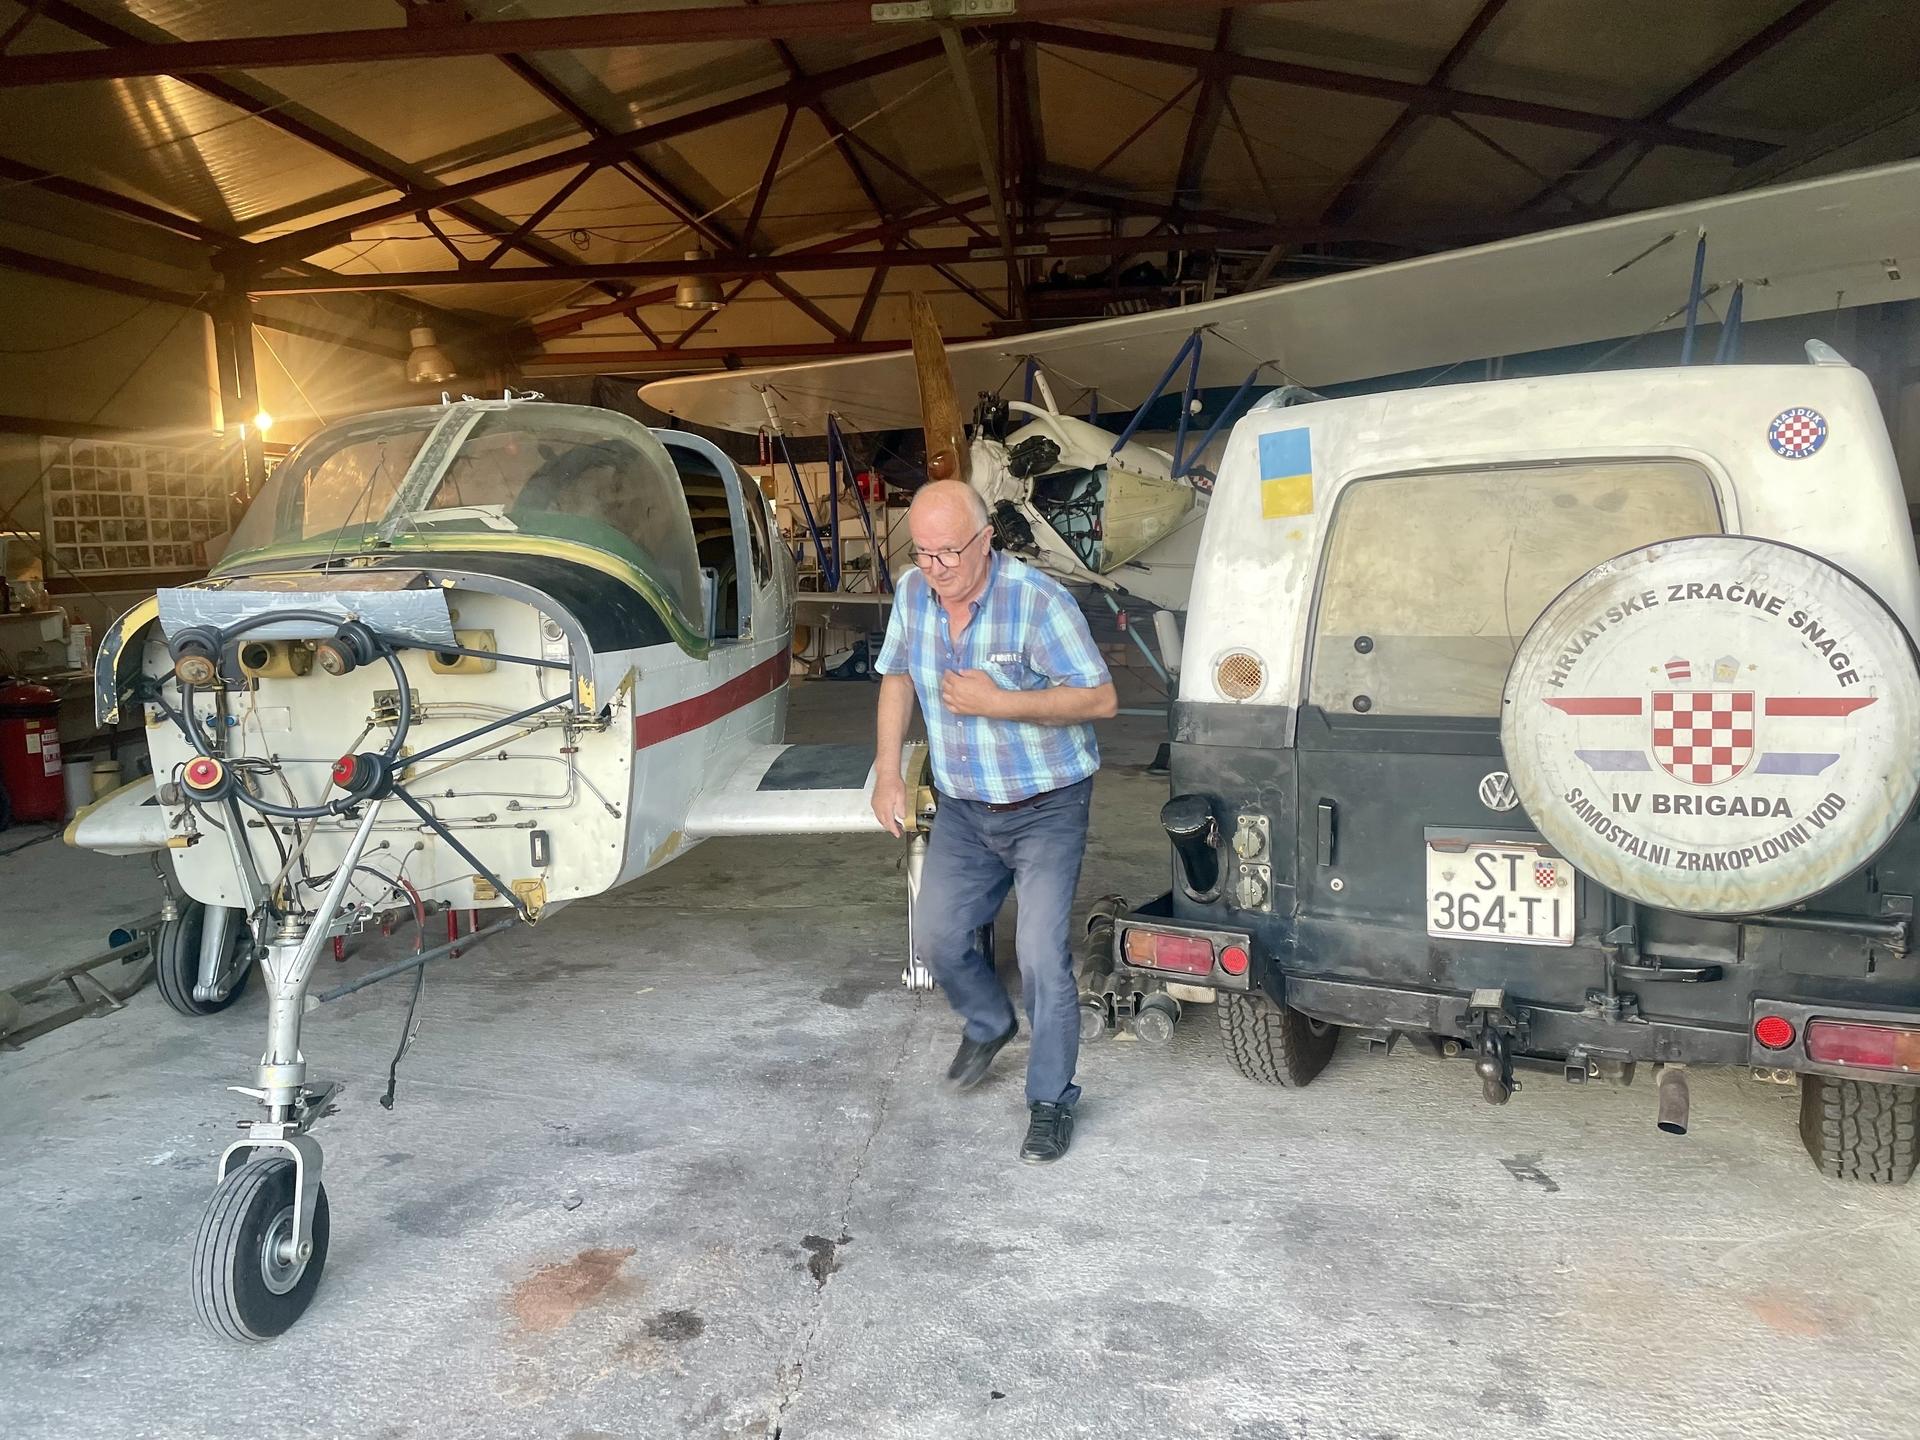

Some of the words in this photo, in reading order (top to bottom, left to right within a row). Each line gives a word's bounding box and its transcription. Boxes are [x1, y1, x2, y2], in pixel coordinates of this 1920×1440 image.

[1773, 408, 1822, 427] HAJDUK
[1777, 445, 1816, 458] SPLIT
[1547, 589, 1659, 688] HRVATSKE
[1667, 581, 1786, 616] ZRAČNE
[1788, 610, 1860, 687] SNAGE
[1612, 793, 1642, 813] IV
[1652, 794, 1793, 818] BRIGADA
[1564, 787, 1670, 866] SAMOSTALNI
[1675, 823, 1812, 871] ZRAKOPLOVNI
[1805, 792, 1846, 830] VOD
[1474, 852, 1524, 891] ST
[1433, 891, 1560, 937] 364-TI
